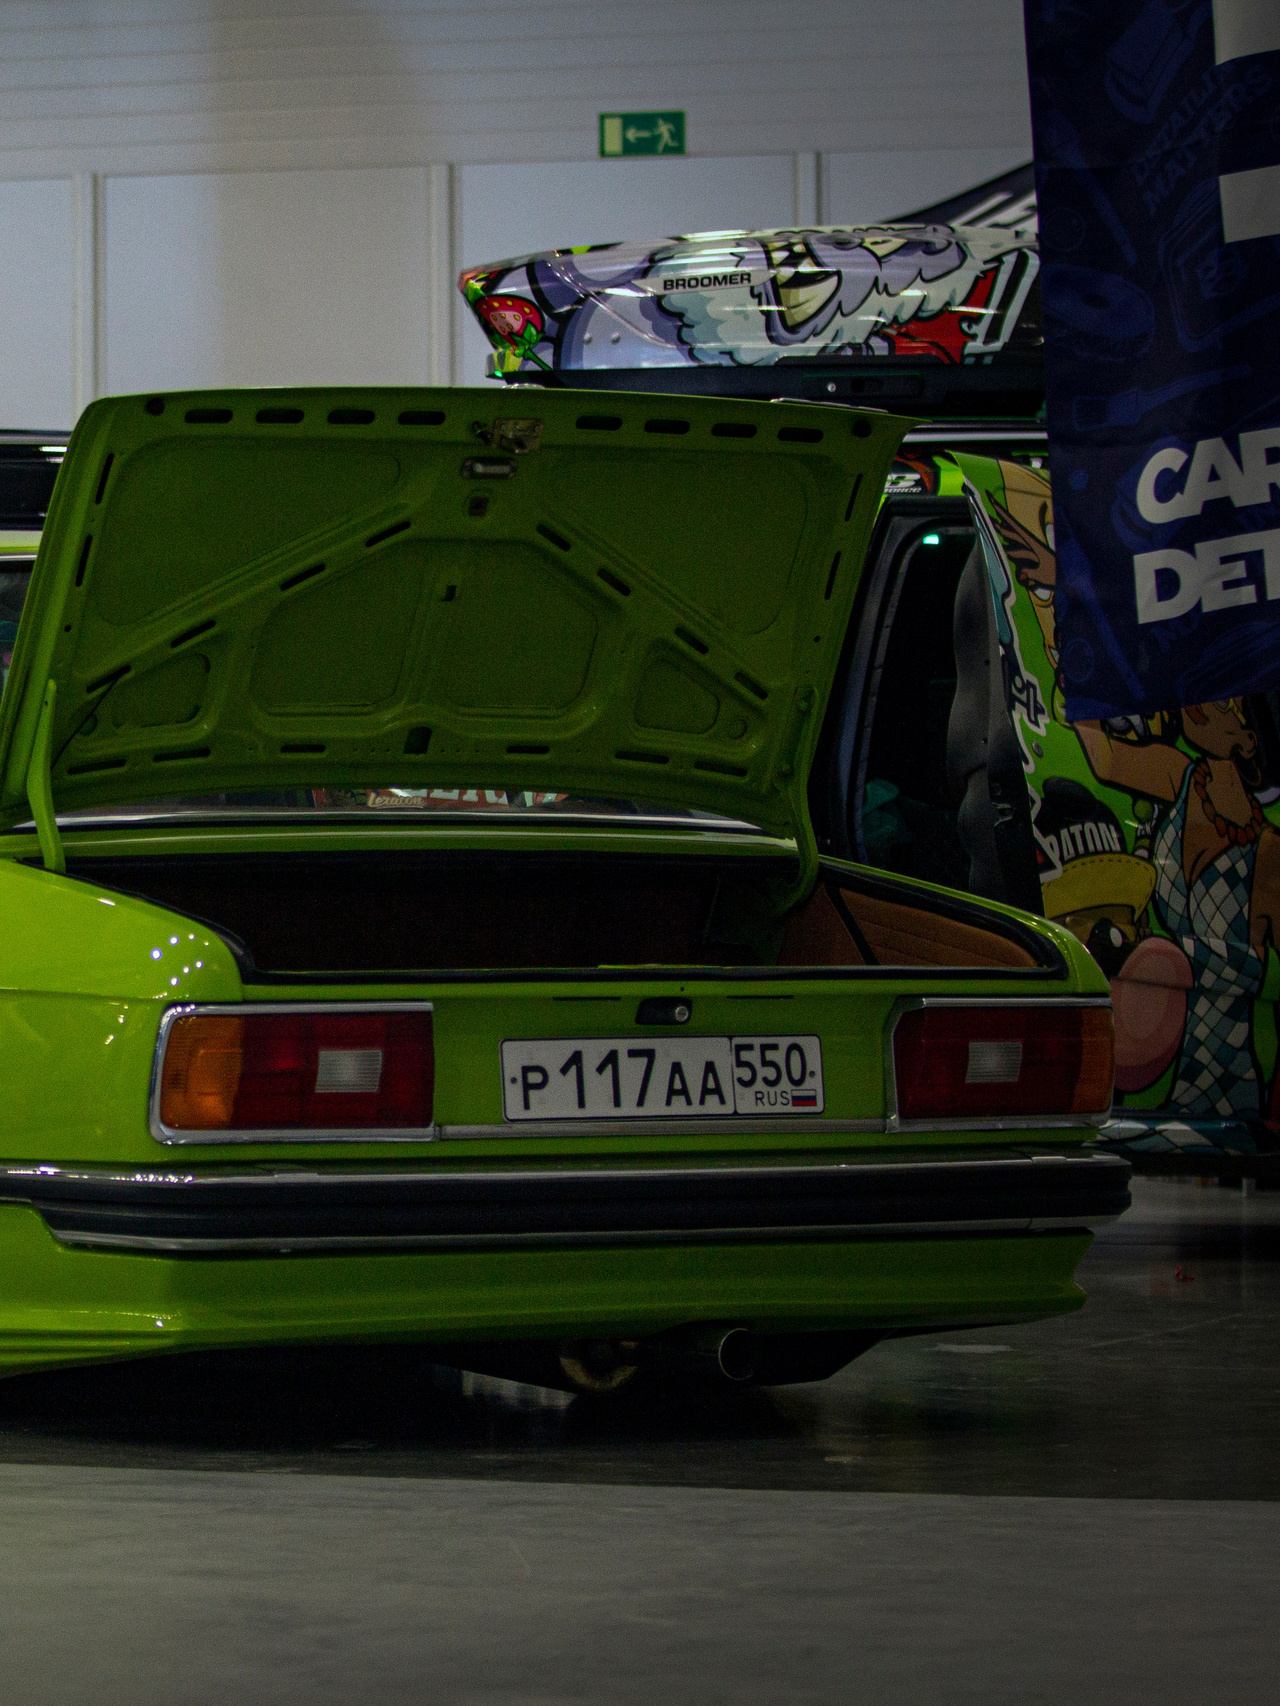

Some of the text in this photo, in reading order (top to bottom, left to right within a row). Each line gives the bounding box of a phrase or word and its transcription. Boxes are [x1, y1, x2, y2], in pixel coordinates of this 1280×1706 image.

[663, 272, 752, 291] BROOMER
[734, 1043, 808, 1088] 550
[755, 1090, 790, 1106] RUS
